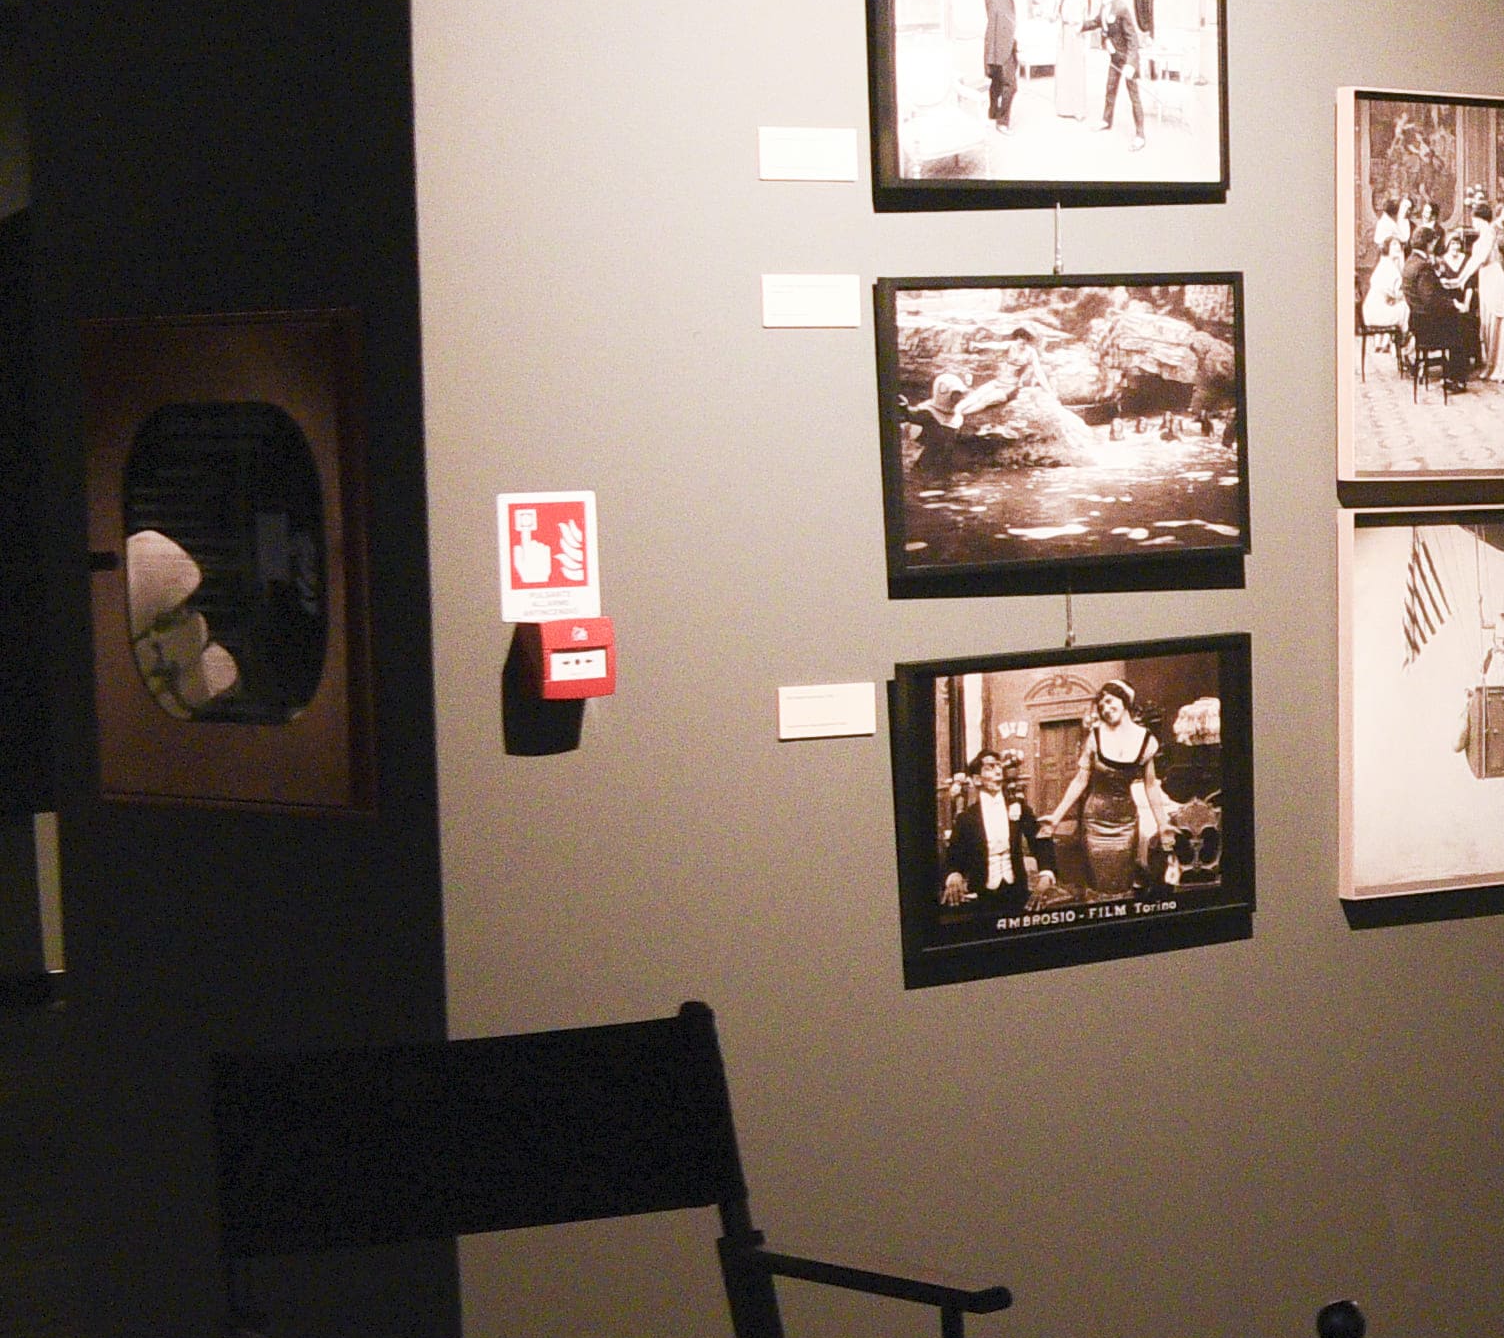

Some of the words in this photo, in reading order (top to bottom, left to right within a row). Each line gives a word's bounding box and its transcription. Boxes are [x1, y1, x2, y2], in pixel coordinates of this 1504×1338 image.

[996, 910, 1075, 931] AMBROSIO
[1088, 904, 1128, 919] FILM
[1134, 900, 1177, 914] Torino
